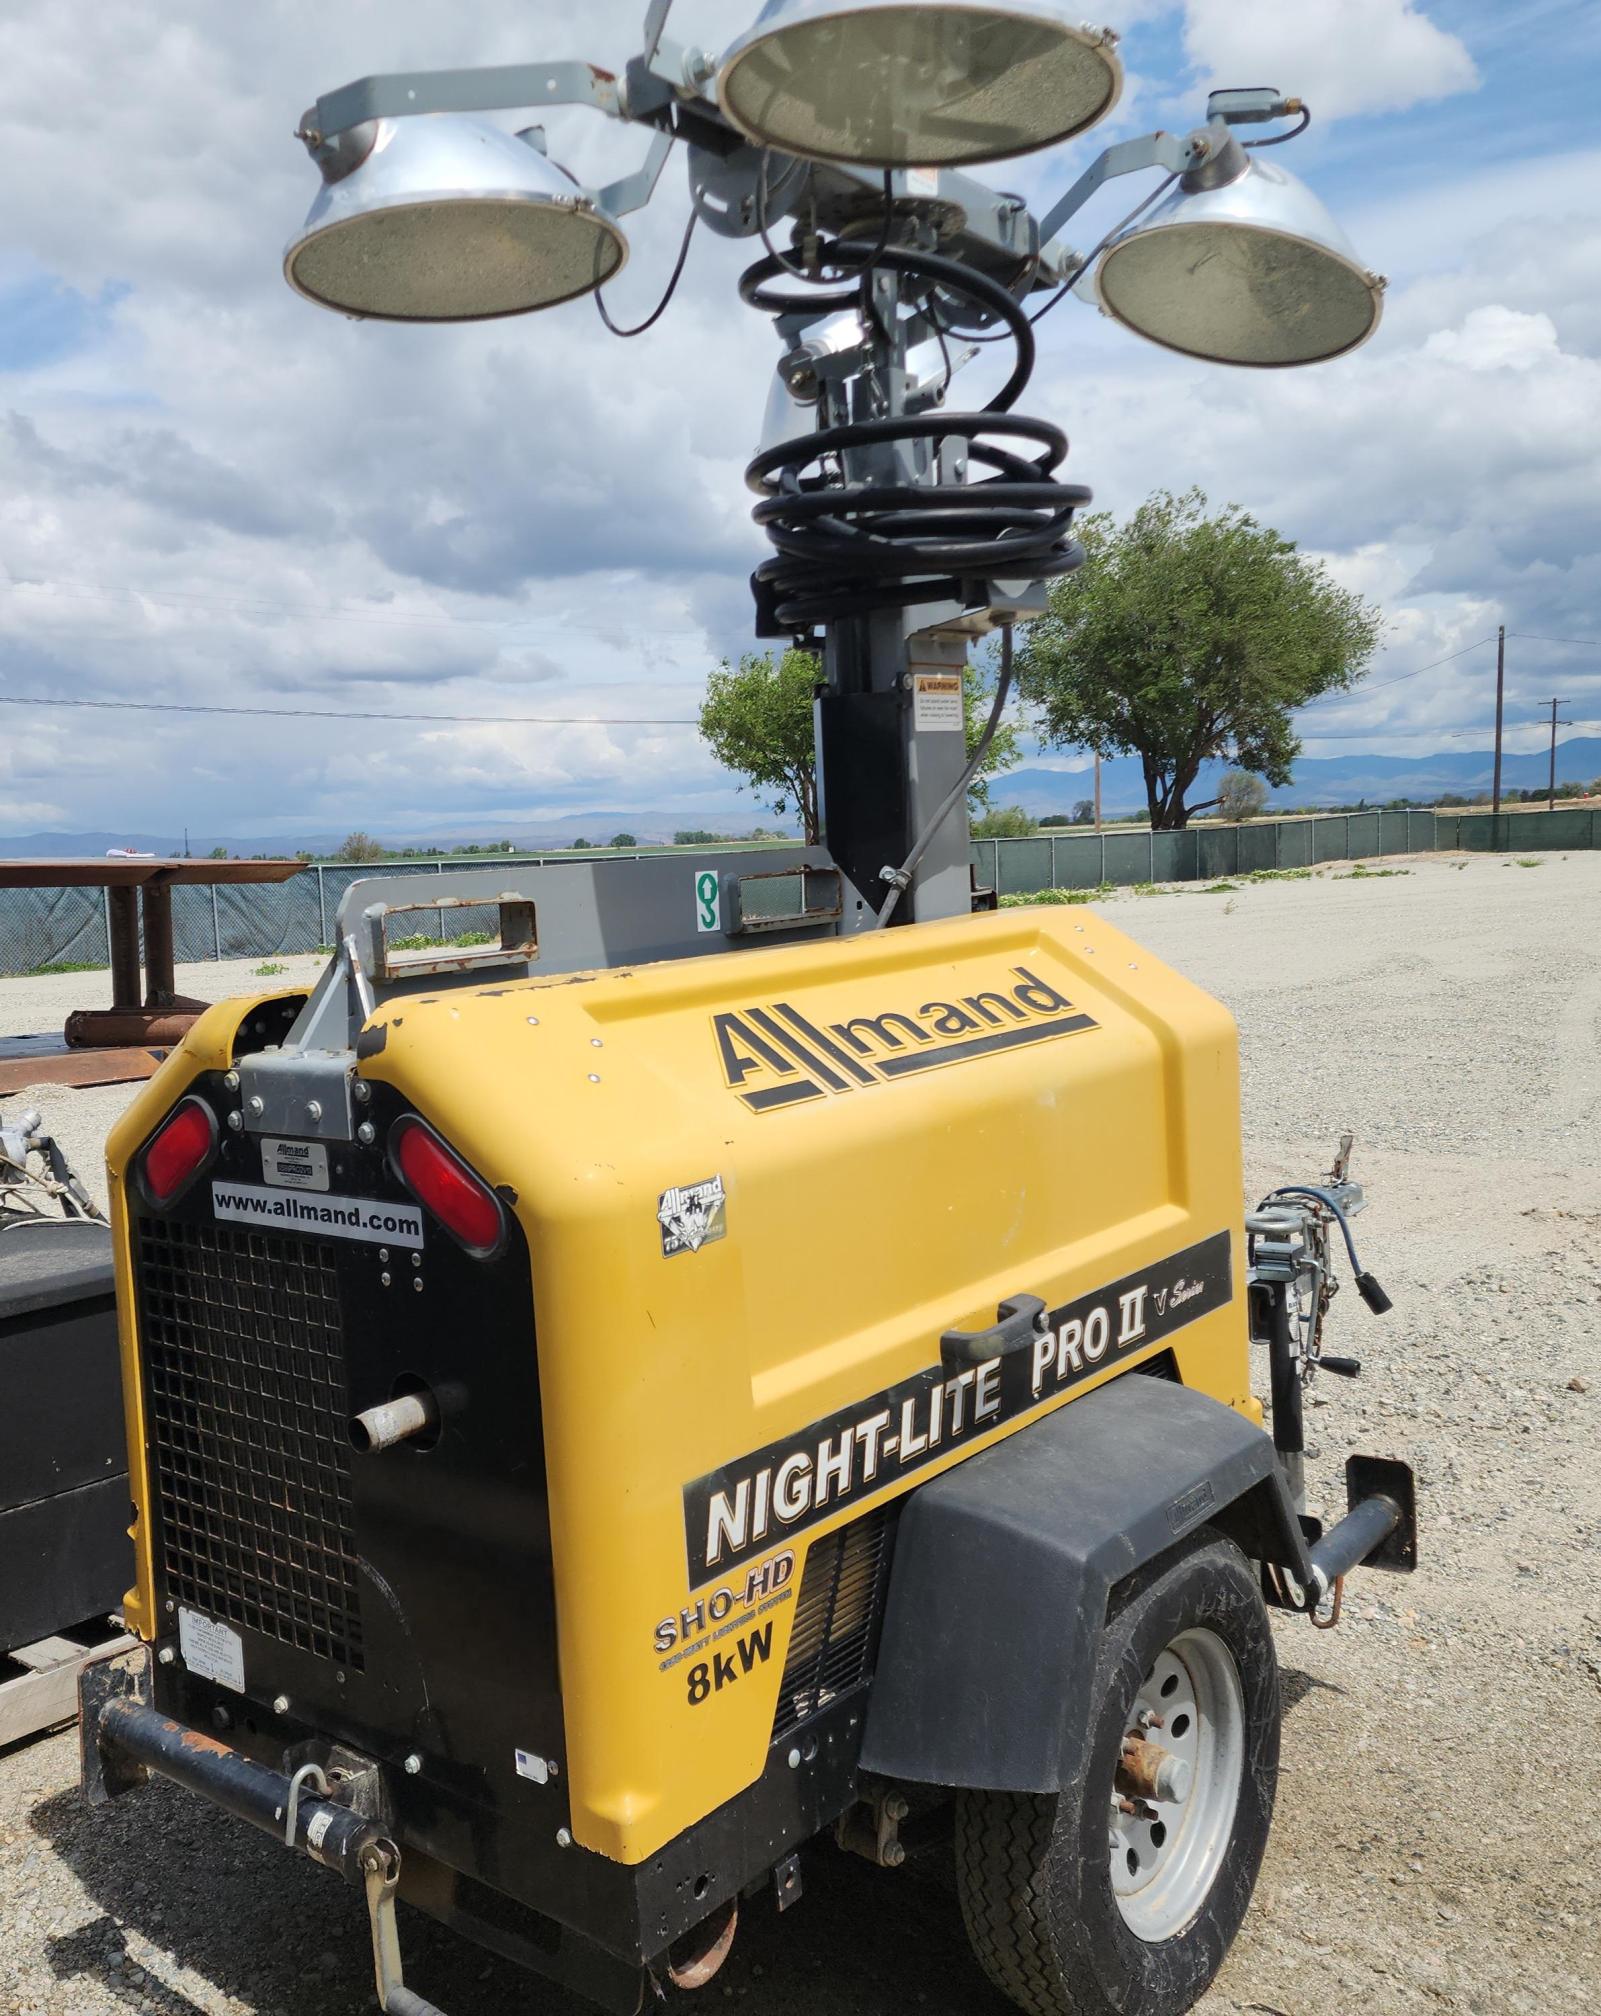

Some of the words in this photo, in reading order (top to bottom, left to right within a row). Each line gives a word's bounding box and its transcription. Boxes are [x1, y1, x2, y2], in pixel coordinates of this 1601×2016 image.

[711, 967, 1077, 1096] Allmand
[277, 1144, 310, 1156] Allmand
[215, 1192, 419, 1236] www.allmand.com
[706, 1356, 1001, 1566] NIGHT-LITE
[1032, 1307, 1110, 1394] PRO
[1117, 1285, 1148, 1349] II
[1153, 1288, 1168, 1315] V
[654, 1549, 795, 1653] SHO-HD
[687, 1621, 773, 1706] 8kW
